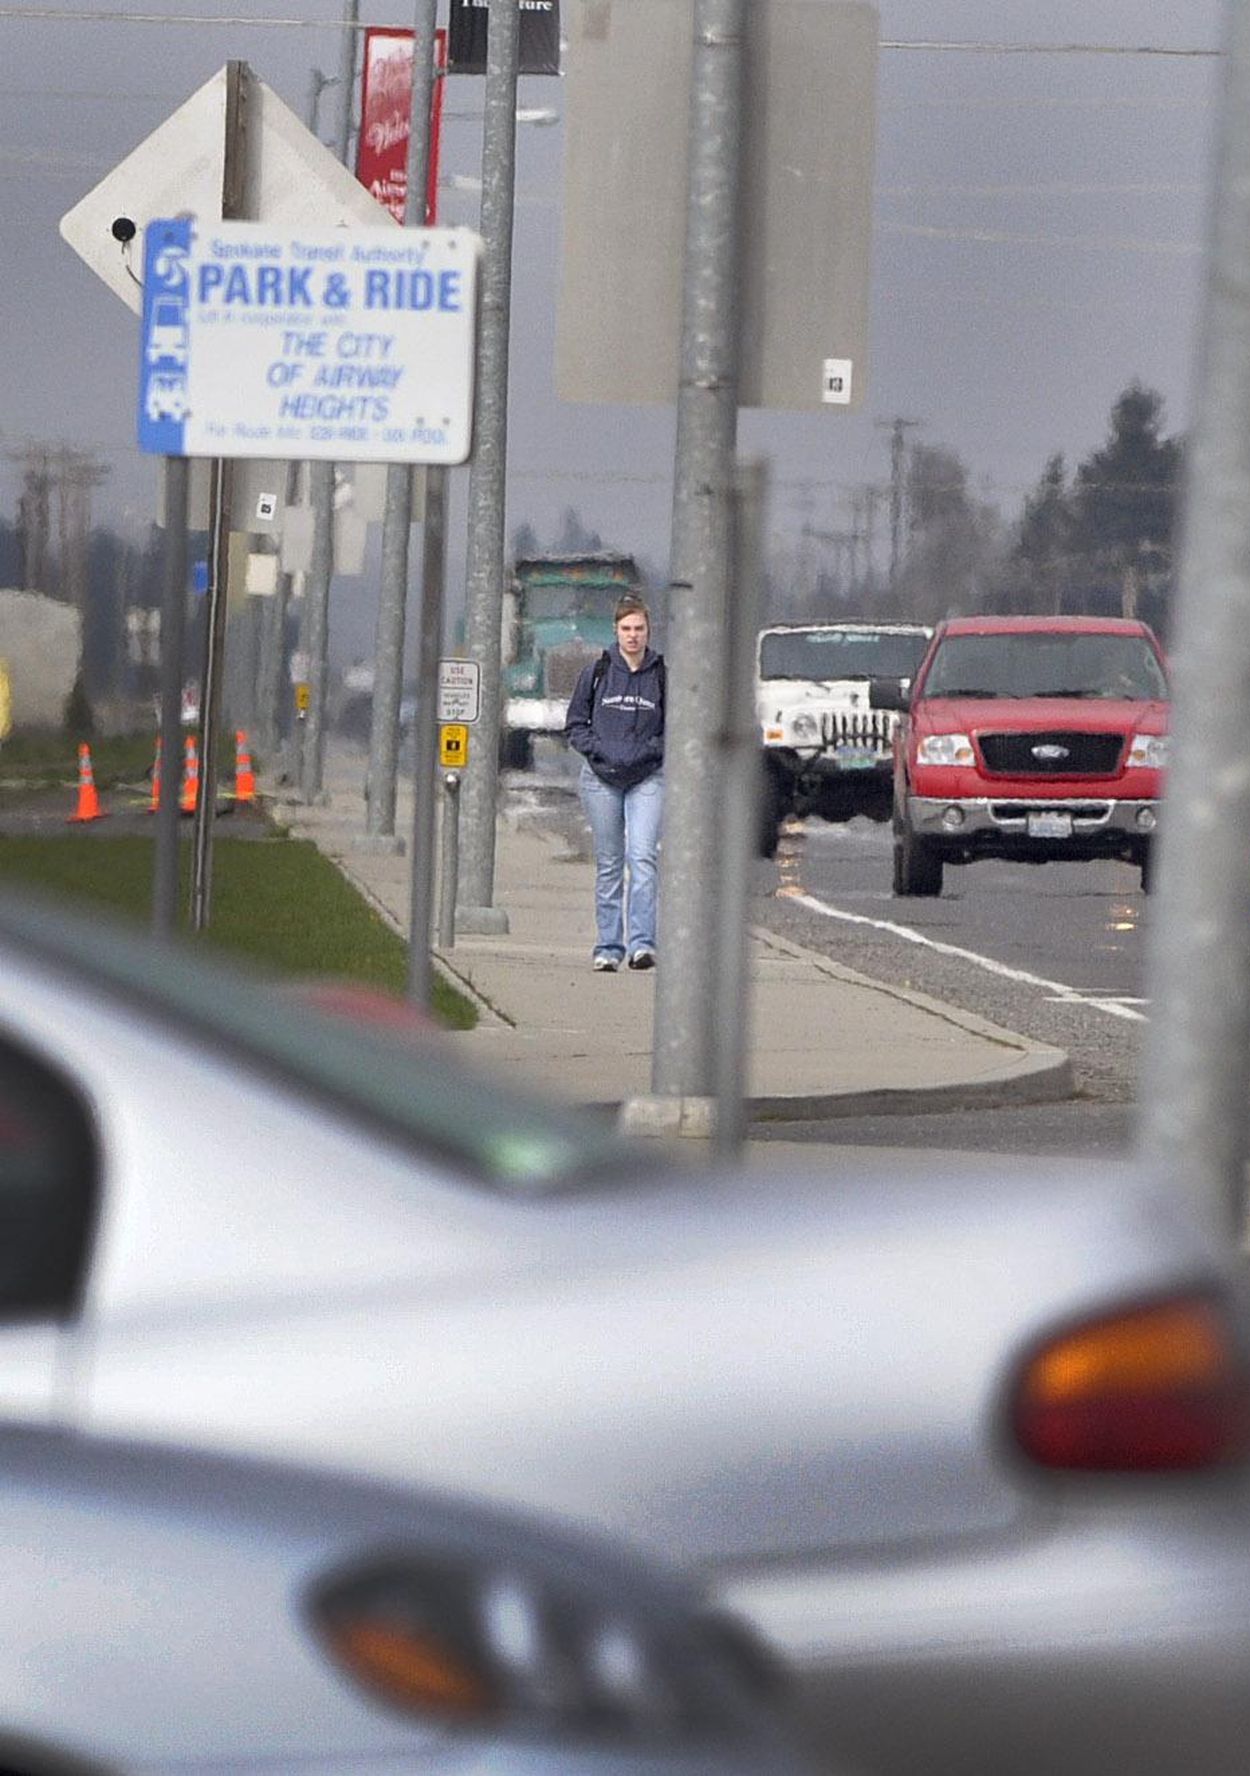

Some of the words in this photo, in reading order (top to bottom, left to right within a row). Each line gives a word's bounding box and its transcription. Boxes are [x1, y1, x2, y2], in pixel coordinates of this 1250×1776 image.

[210, 238, 282, 260] Spokane
[291, 241, 345, 261] Transit
[351, 243, 426, 265] Authority
[199, 264, 314, 306] PARK
[322, 271, 349, 309] &
[364, 269, 462, 313] RIDE
[281, 331, 328, 357] THE
[336, 331, 395, 358] CITY
[266, 361, 306, 388] OF
[314, 364, 405, 389] AIRWAY
[279, 393, 390, 421] HEIGHTS
[440, 676, 473, 686] CAUTION
[451, 666, 465, 675] USE
